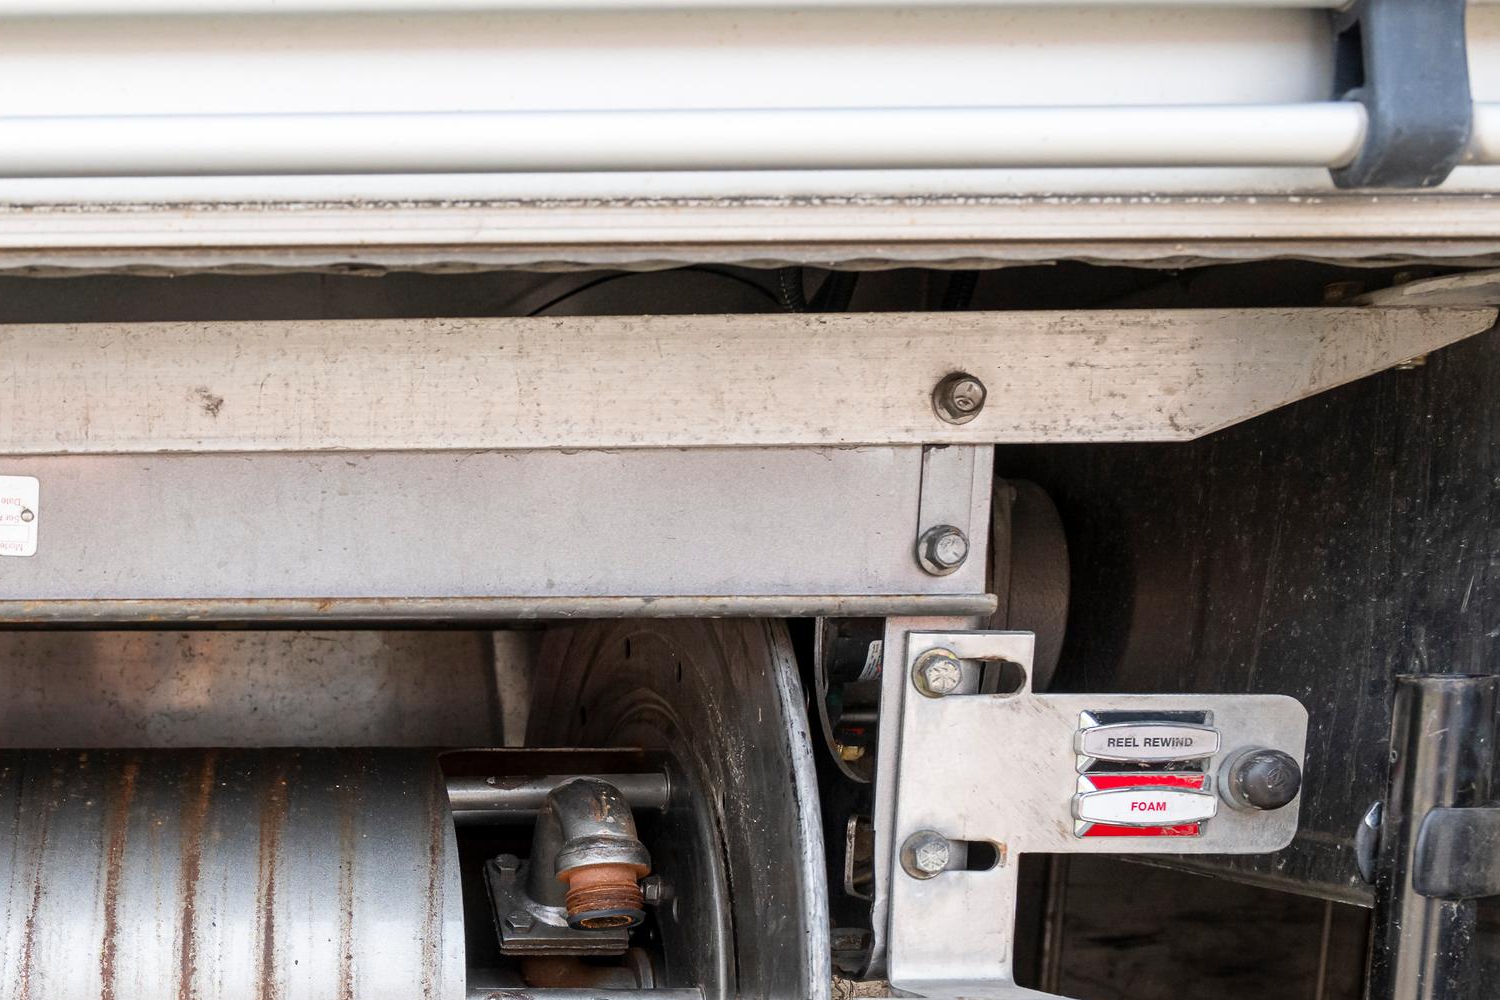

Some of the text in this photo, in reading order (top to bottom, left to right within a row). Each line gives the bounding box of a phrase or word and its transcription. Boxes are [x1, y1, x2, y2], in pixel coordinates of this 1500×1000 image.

[1, 497, 21, 506] Date
[1107, 737, 1193, 748] REEL REWIND
[1131, 801, 1167, 812] FOAM
